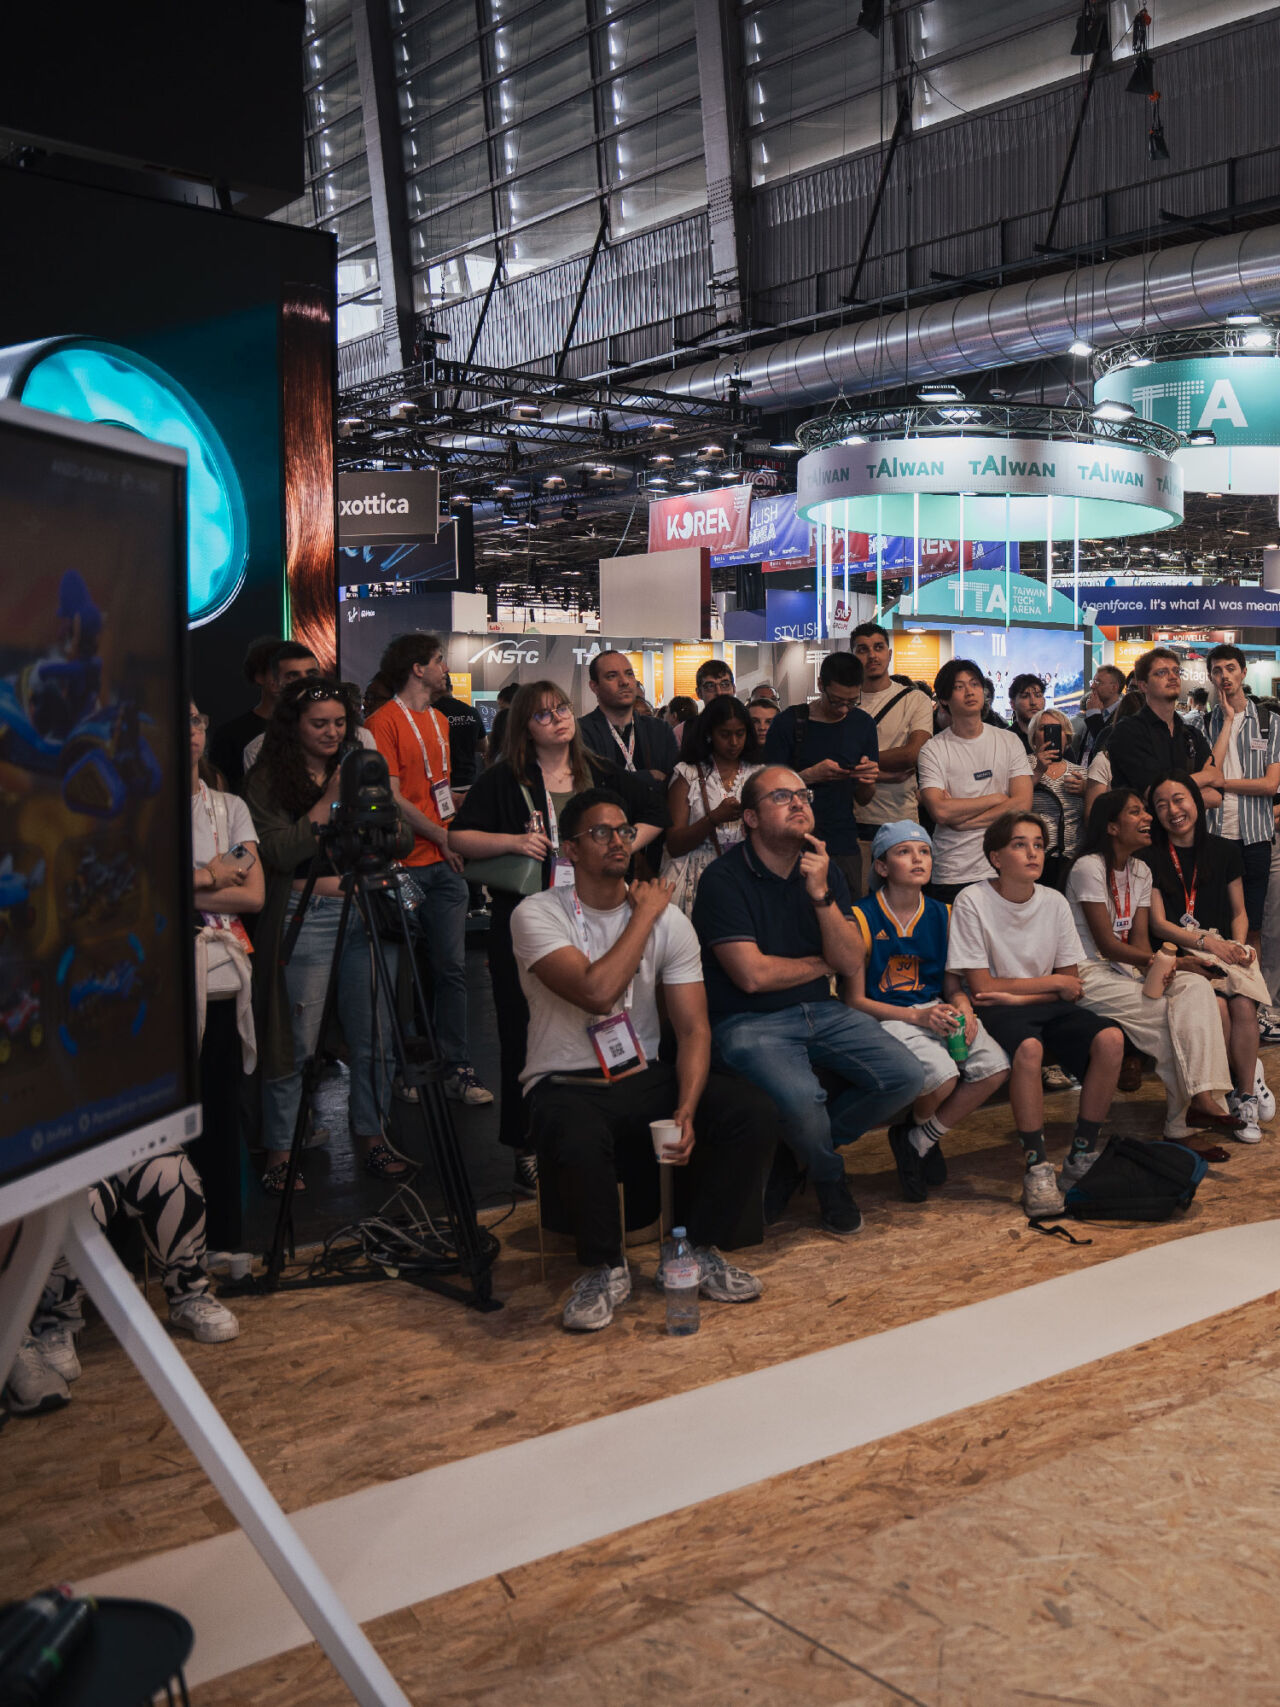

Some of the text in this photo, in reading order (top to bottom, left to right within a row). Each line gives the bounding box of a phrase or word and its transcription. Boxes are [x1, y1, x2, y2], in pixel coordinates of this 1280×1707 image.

[1132, 378, 1248, 430] TTA
[866, 457, 944, 479] TAIWAN
[968, 455, 1056, 478] TAIWAN
[1077, 461, 1144, 488] TAIWAN
[666, 507, 732, 541] KOREA
[947, 580, 1007, 614] TTA
[1149, 598, 1167, 610] It's
[1169, 598, 1200, 611] what
[1202, 598, 1216, 610] AI
[1218, 601, 1243, 611] was
[1012, 605, 1042, 615] ARENA
[486, 649, 540, 664] NSTC
